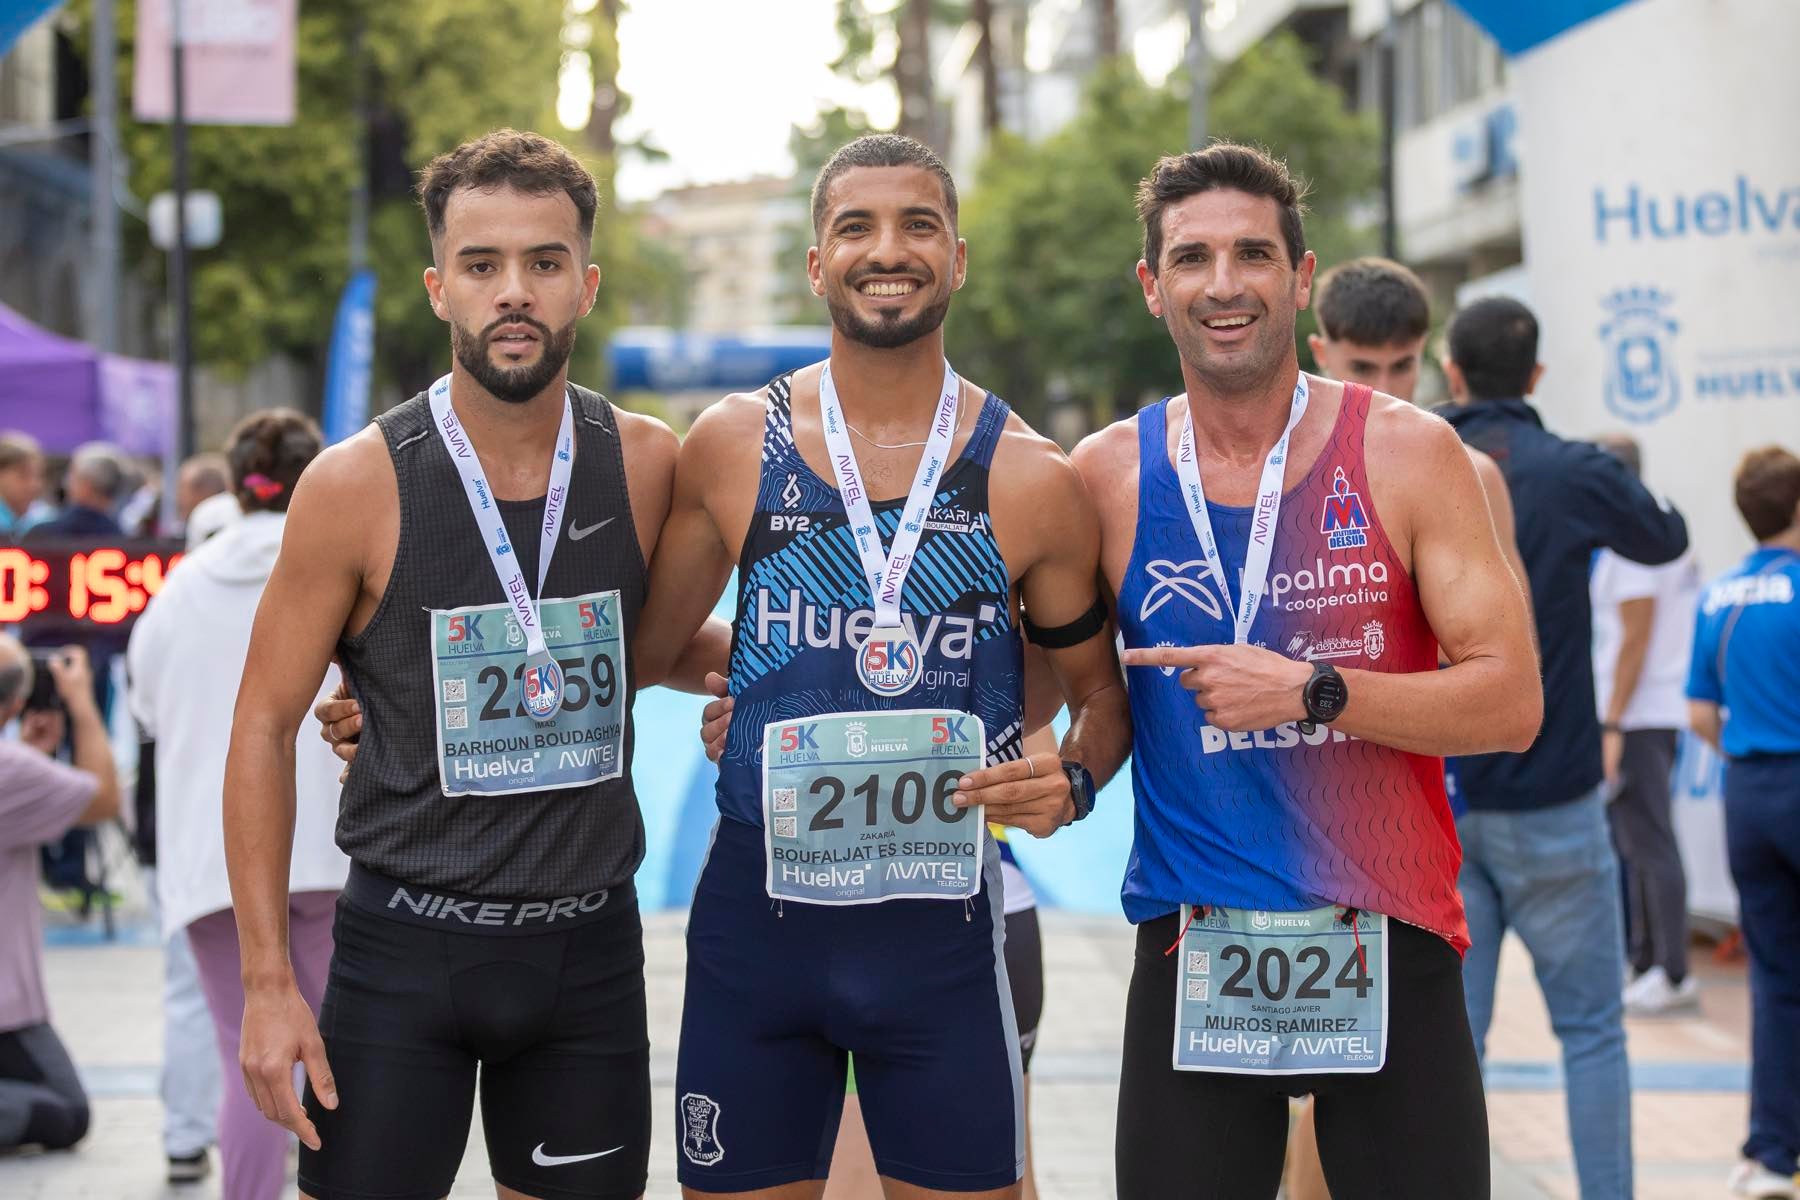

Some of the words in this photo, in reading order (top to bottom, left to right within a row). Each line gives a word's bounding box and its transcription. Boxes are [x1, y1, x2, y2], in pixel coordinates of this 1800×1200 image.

[1594, 174, 1800, 243] Huelv
[826, 406, 839, 434] Huelva
[937, 394, 955, 439] AVATEL
[442, 412, 471, 458] AVATEL
[837, 455, 862, 506] AVATEL
[922, 457, 939, 487] Huelva
[474, 479, 490, 510] Huelva
[1189, 483, 1202, 514] Huelva
[544, 485, 562, 537] AVATEL
[770, 515, 810, 532] BY2
[926, 507, 988, 535] AKARIA
[1254, 490, 1275, 545] AVATEL
[1329, 534, 1366, 549] DELSUR
[882, 553, 907, 604] AVATEL
[508, 574, 535, 627] AVATEL
[1242, 592, 1255, 624] Huelva
[1285, 588, 1388, 615] cooperativa
[448, 613, 485, 642] 5K
[578, 600, 612, 629] 5K
[757, 588, 974, 660] Hueva
[583, 630, 613, 641] HUELVA
[1316, 637, 1363, 651] deportes
[448, 643, 485, 655] HUELVA
[867, 640, 911, 671] 5K
[525, 663, 555, 700] 5K
[868, 674, 912, 685] HUELVA
[920, 665, 971, 690] iginal
[534, 721, 557, 730] IMAD
[780, 723, 820, 753] 5K
[931, 716, 971, 744] 5K
[445, 735, 530, 757] BARHOUN
[534, 723, 621, 748] BOUDAGHYA
[870, 743, 909, 753] HUELVA
[931, 743, 970, 756] HUELVA
[454, 757, 534, 780] Huelva
[559, 744, 615, 770] AVATEL
[780, 751, 821, 764] HUELVA
[508, 776, 536, 785] original
[808, 769, 970, 832] 2106
[773, 846, 874, 865] BOUFALJAT
[879, 843, 897, 858] ES
[902, 842, 976, 857] SEDDYQ
[782, 863, 866, 888] Huelva
[885, 862, 969, 881] AVATEL
[936, 880, 969, 888] TELECOM
[835, 887, 865, 898] original
[387, 887, 511, 926] NIKE
[512, 889, 609, 926] PRO
[1195, 918, 1232, 929] HUELVA
[1274, 919, 1311, 927] HUELVA
[1219, 944, 1374, 1002] 2024
[1251, 1004, 1291, 1015] SANTIAGO
[1292, 1004, 1321, 1014] JAVIER
[1205, 1015, 1272, 1033] MUROS
[1276, 1017, 1358, 1034] RAMIREZ
[1189, 1031, 1270, 1056] Huelva
[1291, 1036, 1374, 1056] AVATEL
[1240, 1056, 1270, 1065] original
[1343, 1054, 1375, 1062] TELECOM
